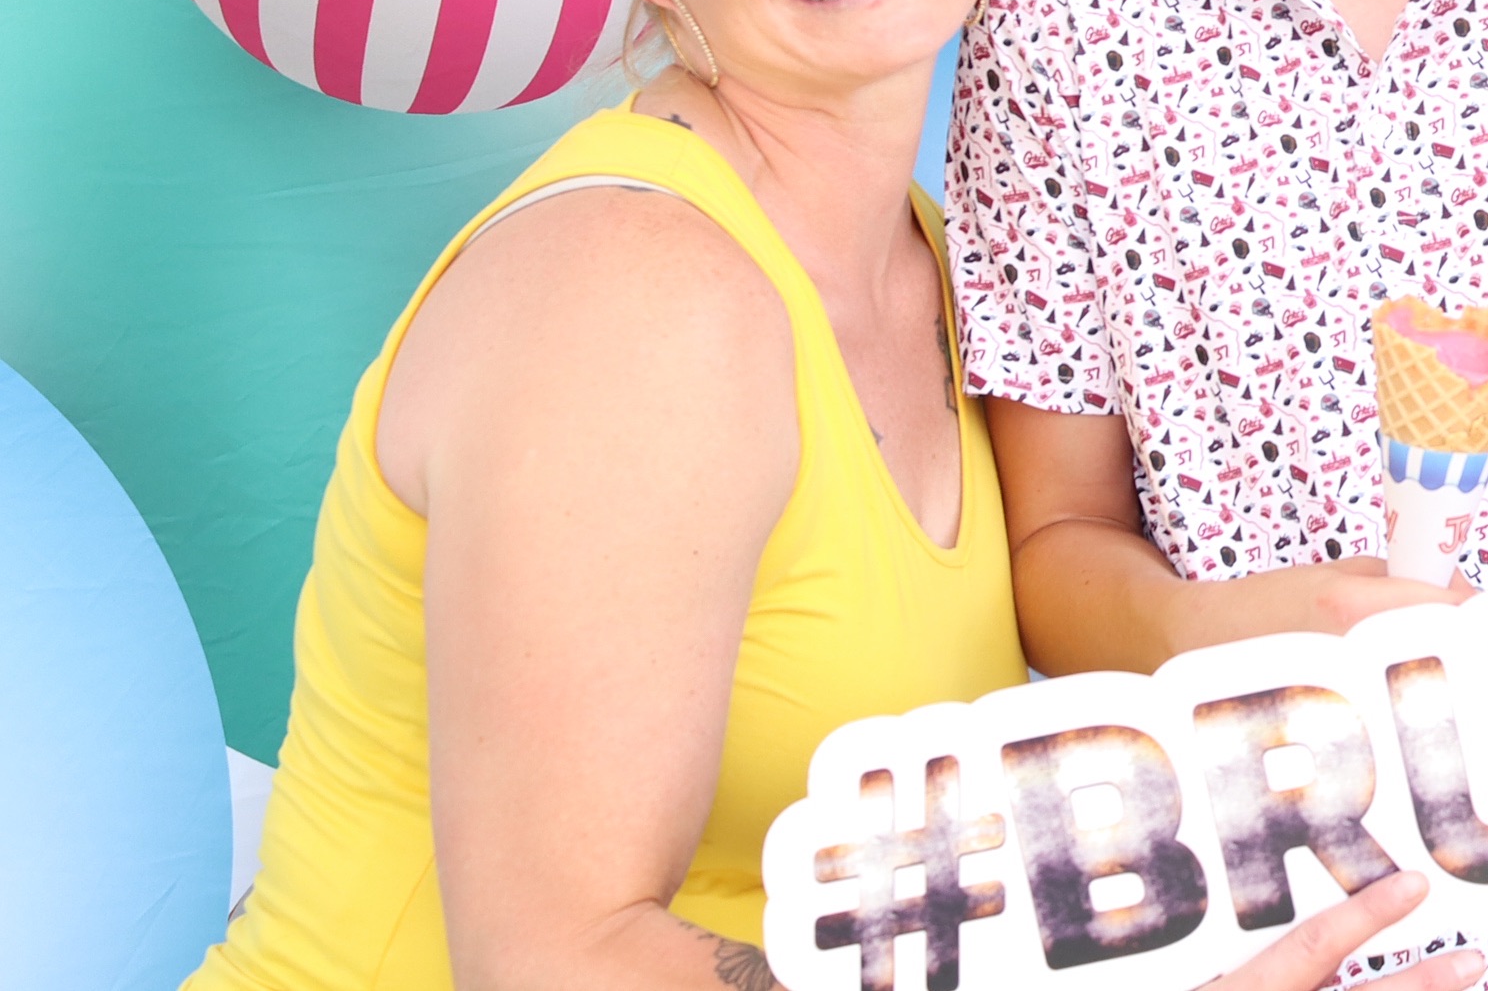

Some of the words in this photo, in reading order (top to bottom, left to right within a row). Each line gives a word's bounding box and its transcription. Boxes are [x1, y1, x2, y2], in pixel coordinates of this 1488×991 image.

[1236, 43, 1250, 56] 37
[1429, 119, 1444, 134] 37
[1307, 132, 1321, 147] 37
[1189, 145, 1204, 161] 37
[1083, 155, 1098, 171] 37
[1394, 187, 1411, 202] 37
[1258, 237, 1274, 253] 37
[1150, 249, 1164, 264] 37
[1026, 269, 1040, 282] 37
[1330, 331, 1346, 347] 37
[1214, 345, 1228, 361] 37
[1084, 367, 1100, 381] 37
[1286, 440, 1299, 456] 37
[1175, 450, 1192, 465] 37
[1350, 538, 1367, 554] 37
[1245, 547, 1260, 562] 37
[1393, 950, 1410, 965] 37
